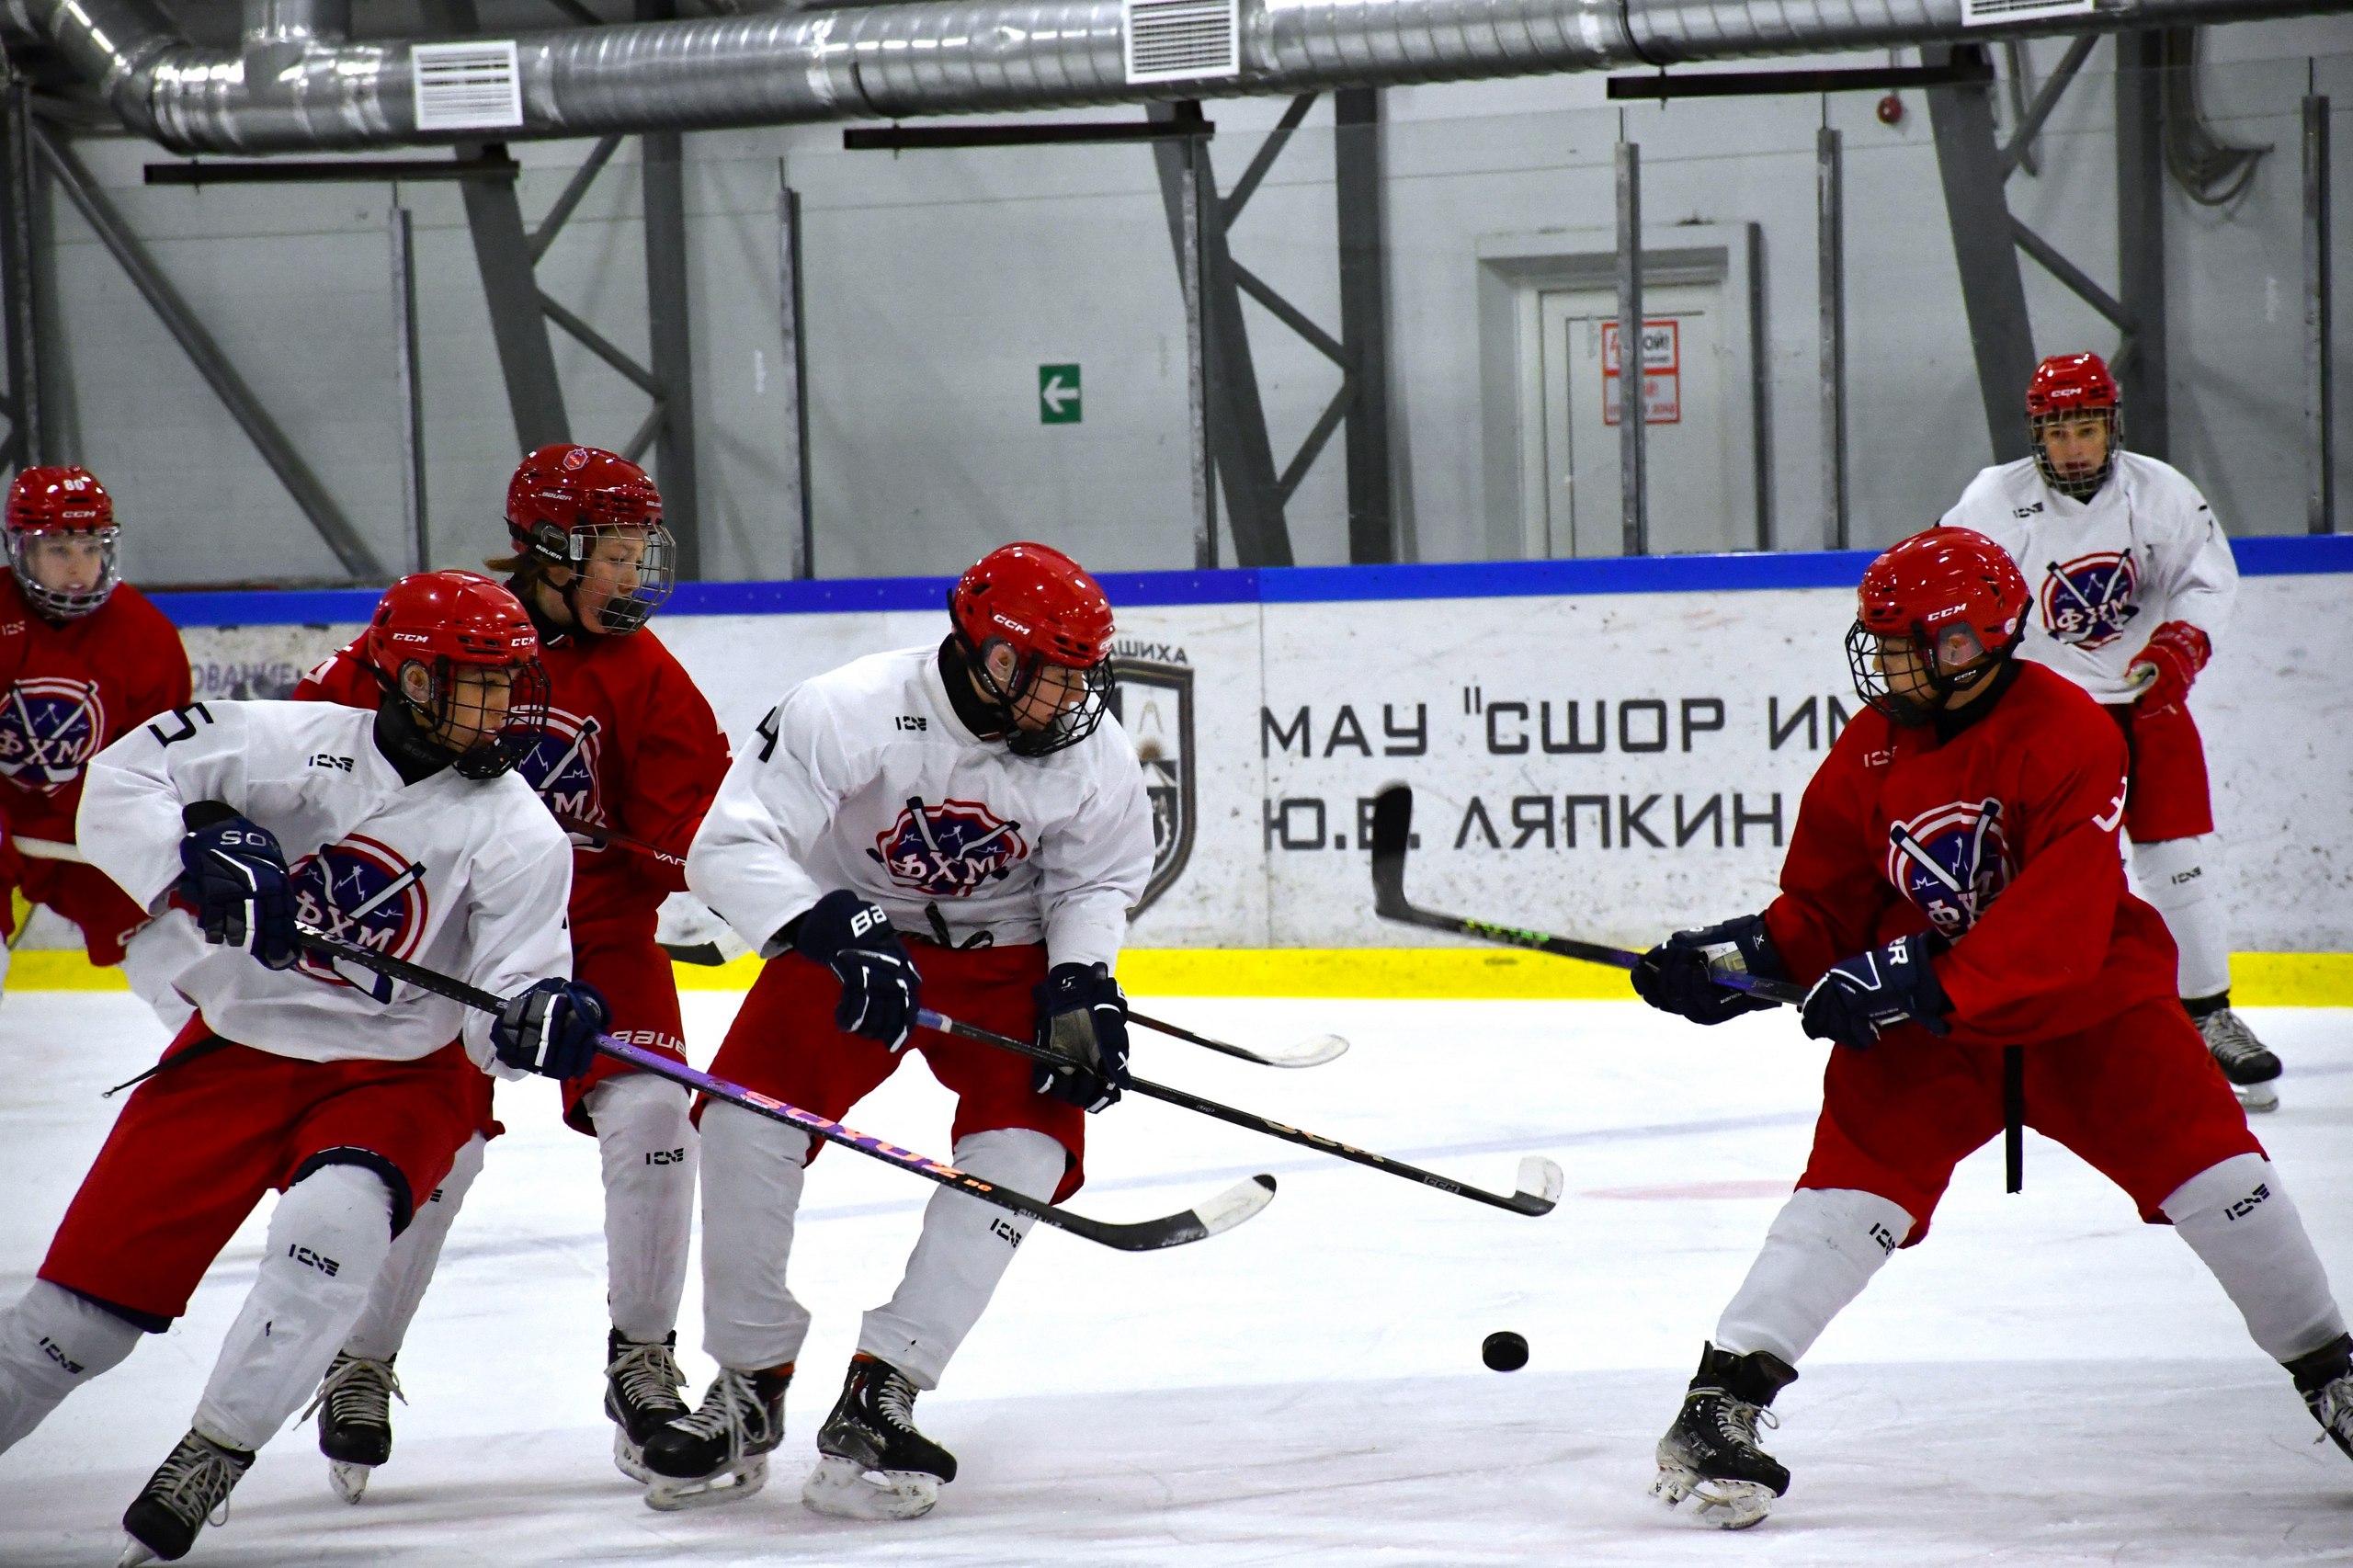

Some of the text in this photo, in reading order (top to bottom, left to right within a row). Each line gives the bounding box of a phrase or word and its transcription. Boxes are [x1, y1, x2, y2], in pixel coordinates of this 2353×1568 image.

[2051, 387, 2082, 398] CCM
[63, 479, 85, 492] 80
[1927, 602, 1967, 621] CCM
[994, 613, 1030, 635] CCM
[392, 632, 429, 642] CCM
[511, 636, 536, 647] CCM
[1954, 669, 1977, 682] CCM
[147, 702, 214, 748] 5
[1261, 703, 1427, 758] МАУ
[1464, 686, 1725, 756] "СШОР
[756, 705, 779, 764] 4
[1453, 792, 1783, 849] ЛЯПКИН
[891, 851, 995, 885] ФХМ
[1426, 1176, 1459, 1194] CCM
